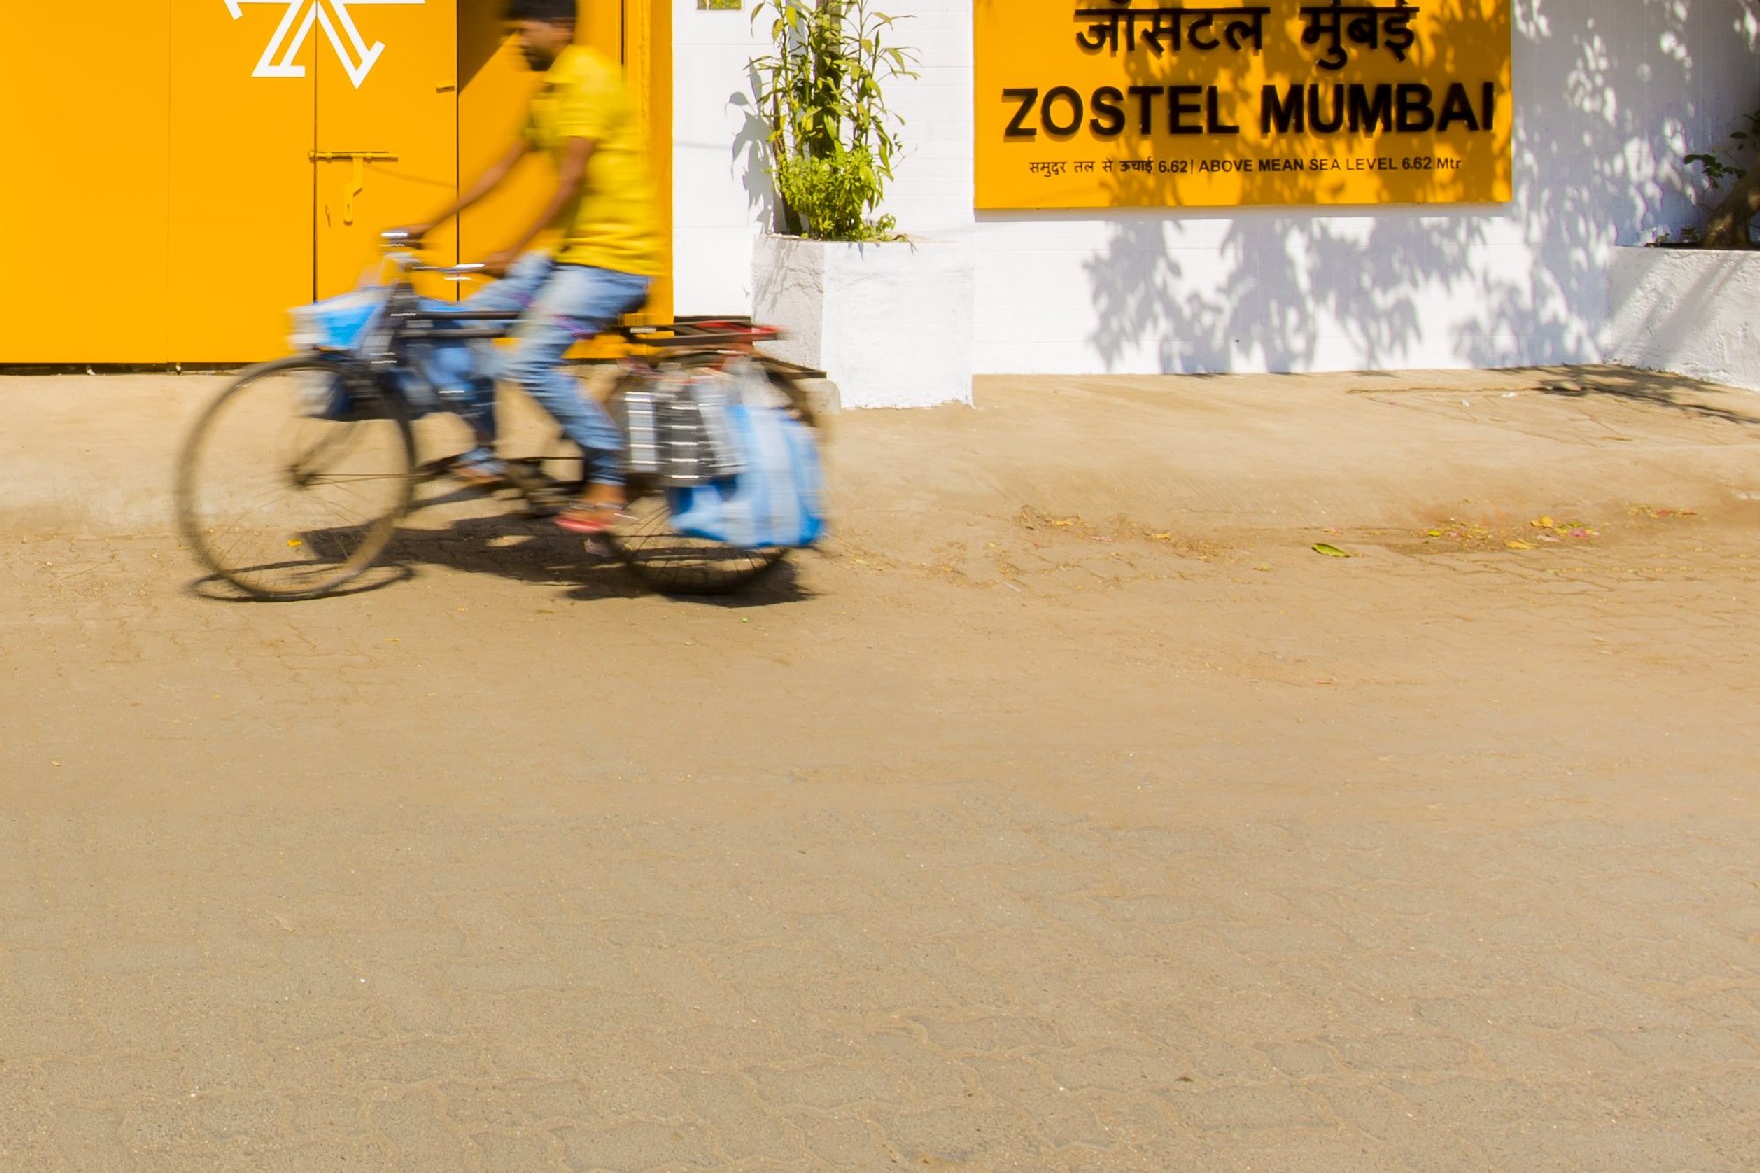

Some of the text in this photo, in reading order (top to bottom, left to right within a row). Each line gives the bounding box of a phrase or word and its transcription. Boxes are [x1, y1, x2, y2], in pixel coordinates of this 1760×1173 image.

[1002, 81, 1494, 137] ZOSTEL MUMBAI
[1073, 160, 1096, 173] तल
[1102, 157, 1114, 173] से
[1198, 156, 1463, 173] ABOVE MEAN SEA LEVEL 6.62 Mtr
